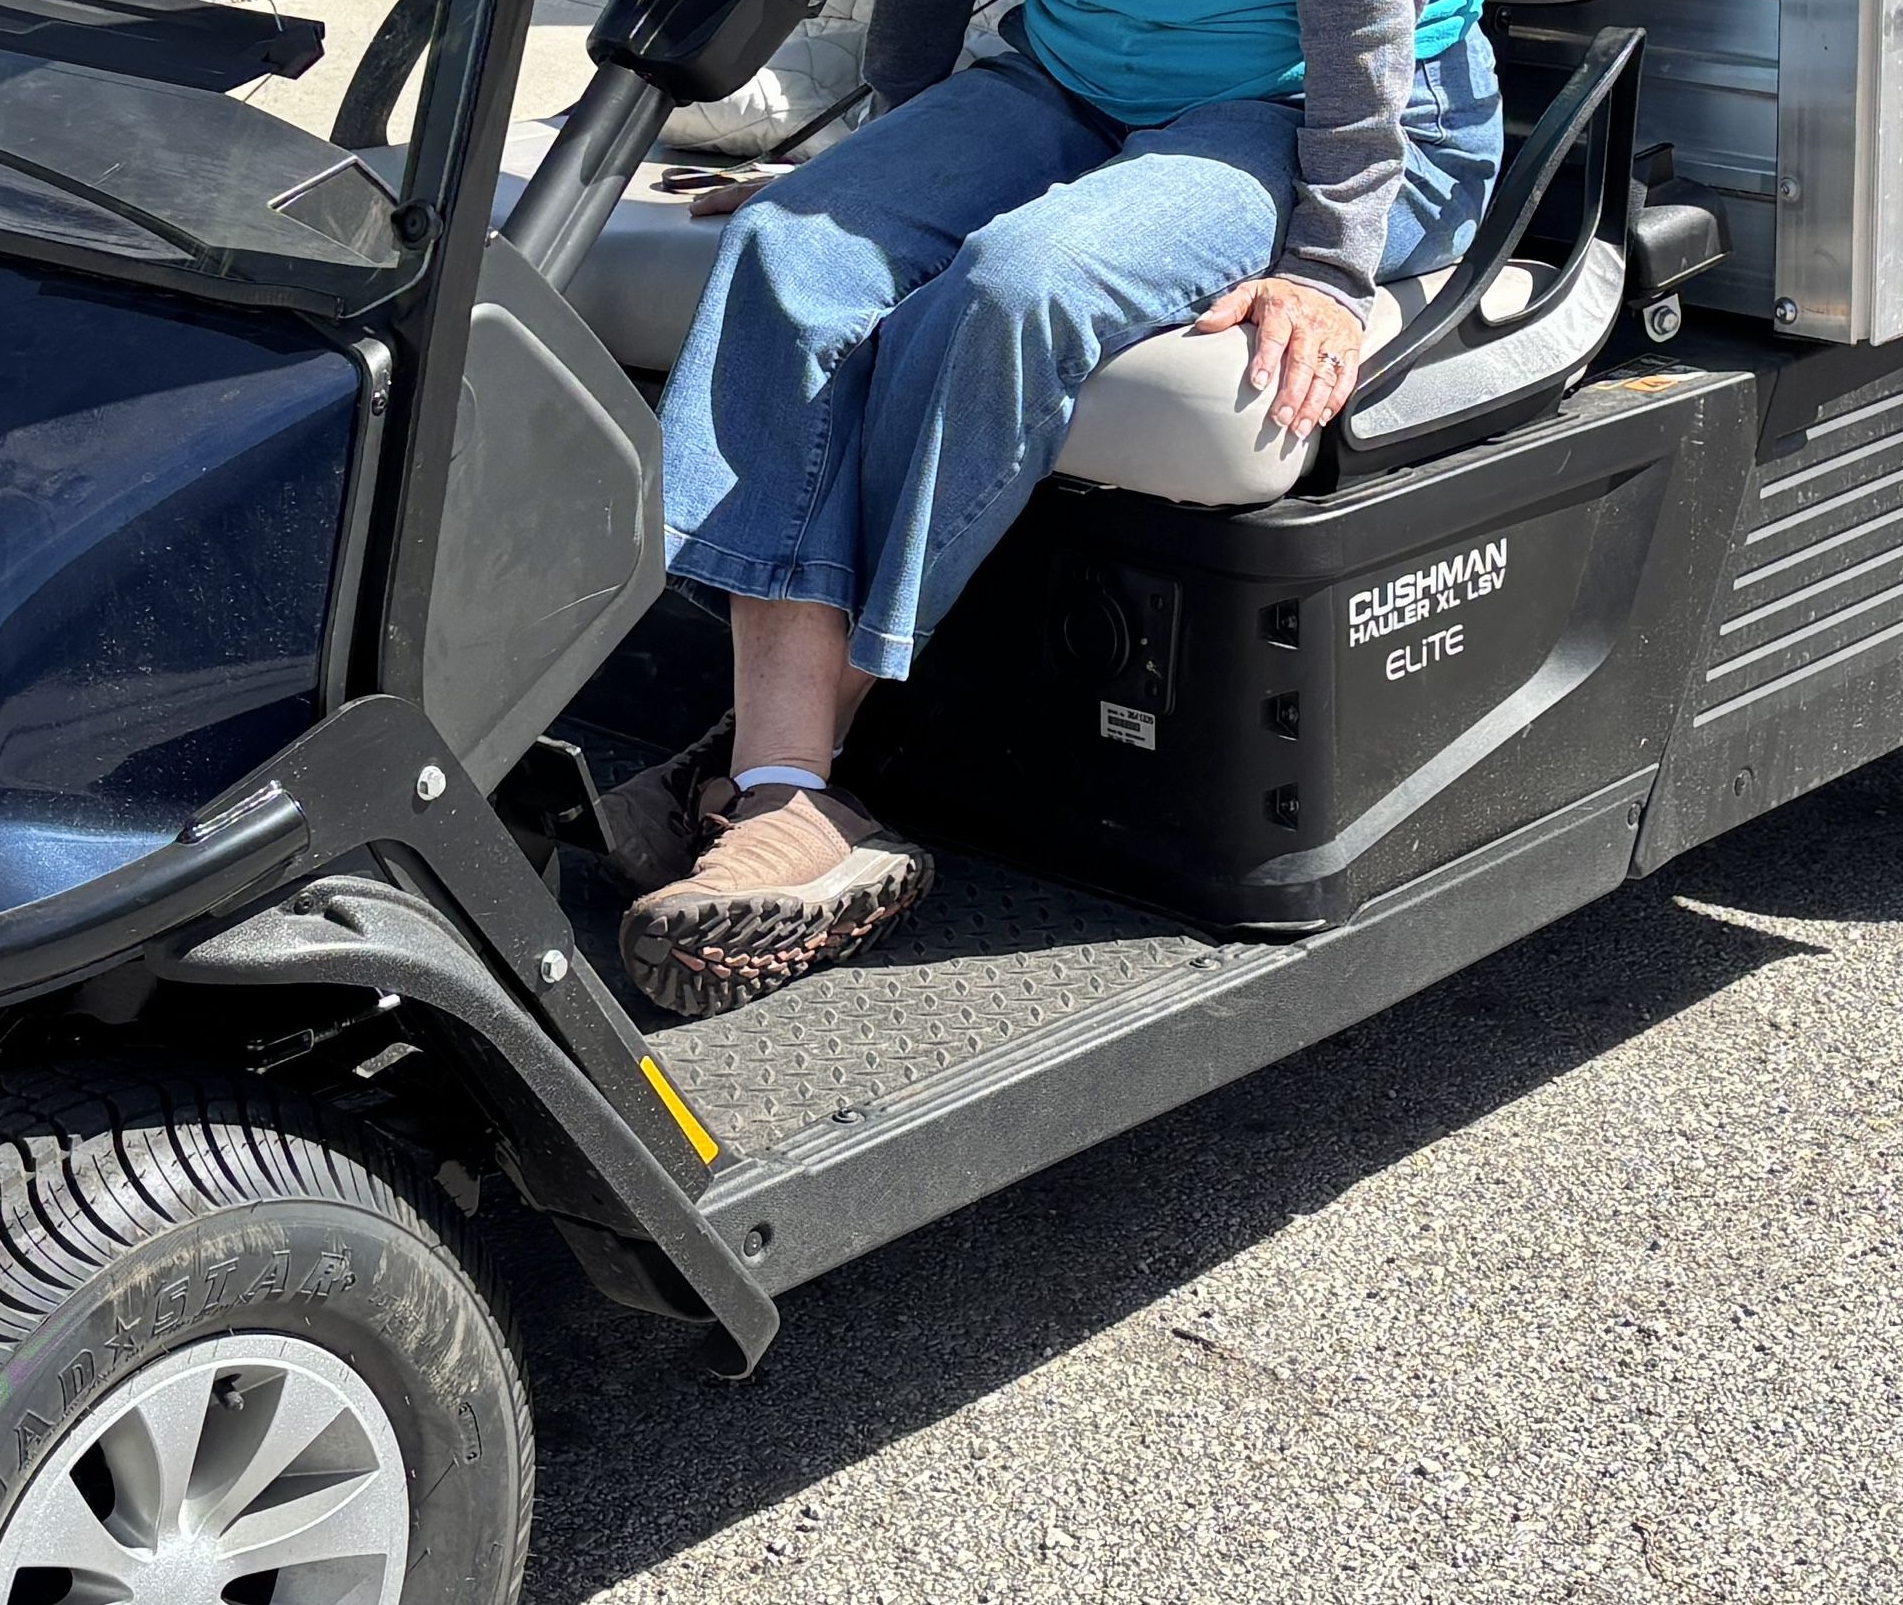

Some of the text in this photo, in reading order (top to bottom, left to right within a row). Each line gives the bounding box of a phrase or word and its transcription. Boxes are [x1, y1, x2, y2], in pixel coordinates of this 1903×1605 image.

[1349, 537, 1508, 627] CUSHMAN
[1349, 567, 1506, 648] HAULER XL LSV
[152, 1248, 351, 1336] STAR
